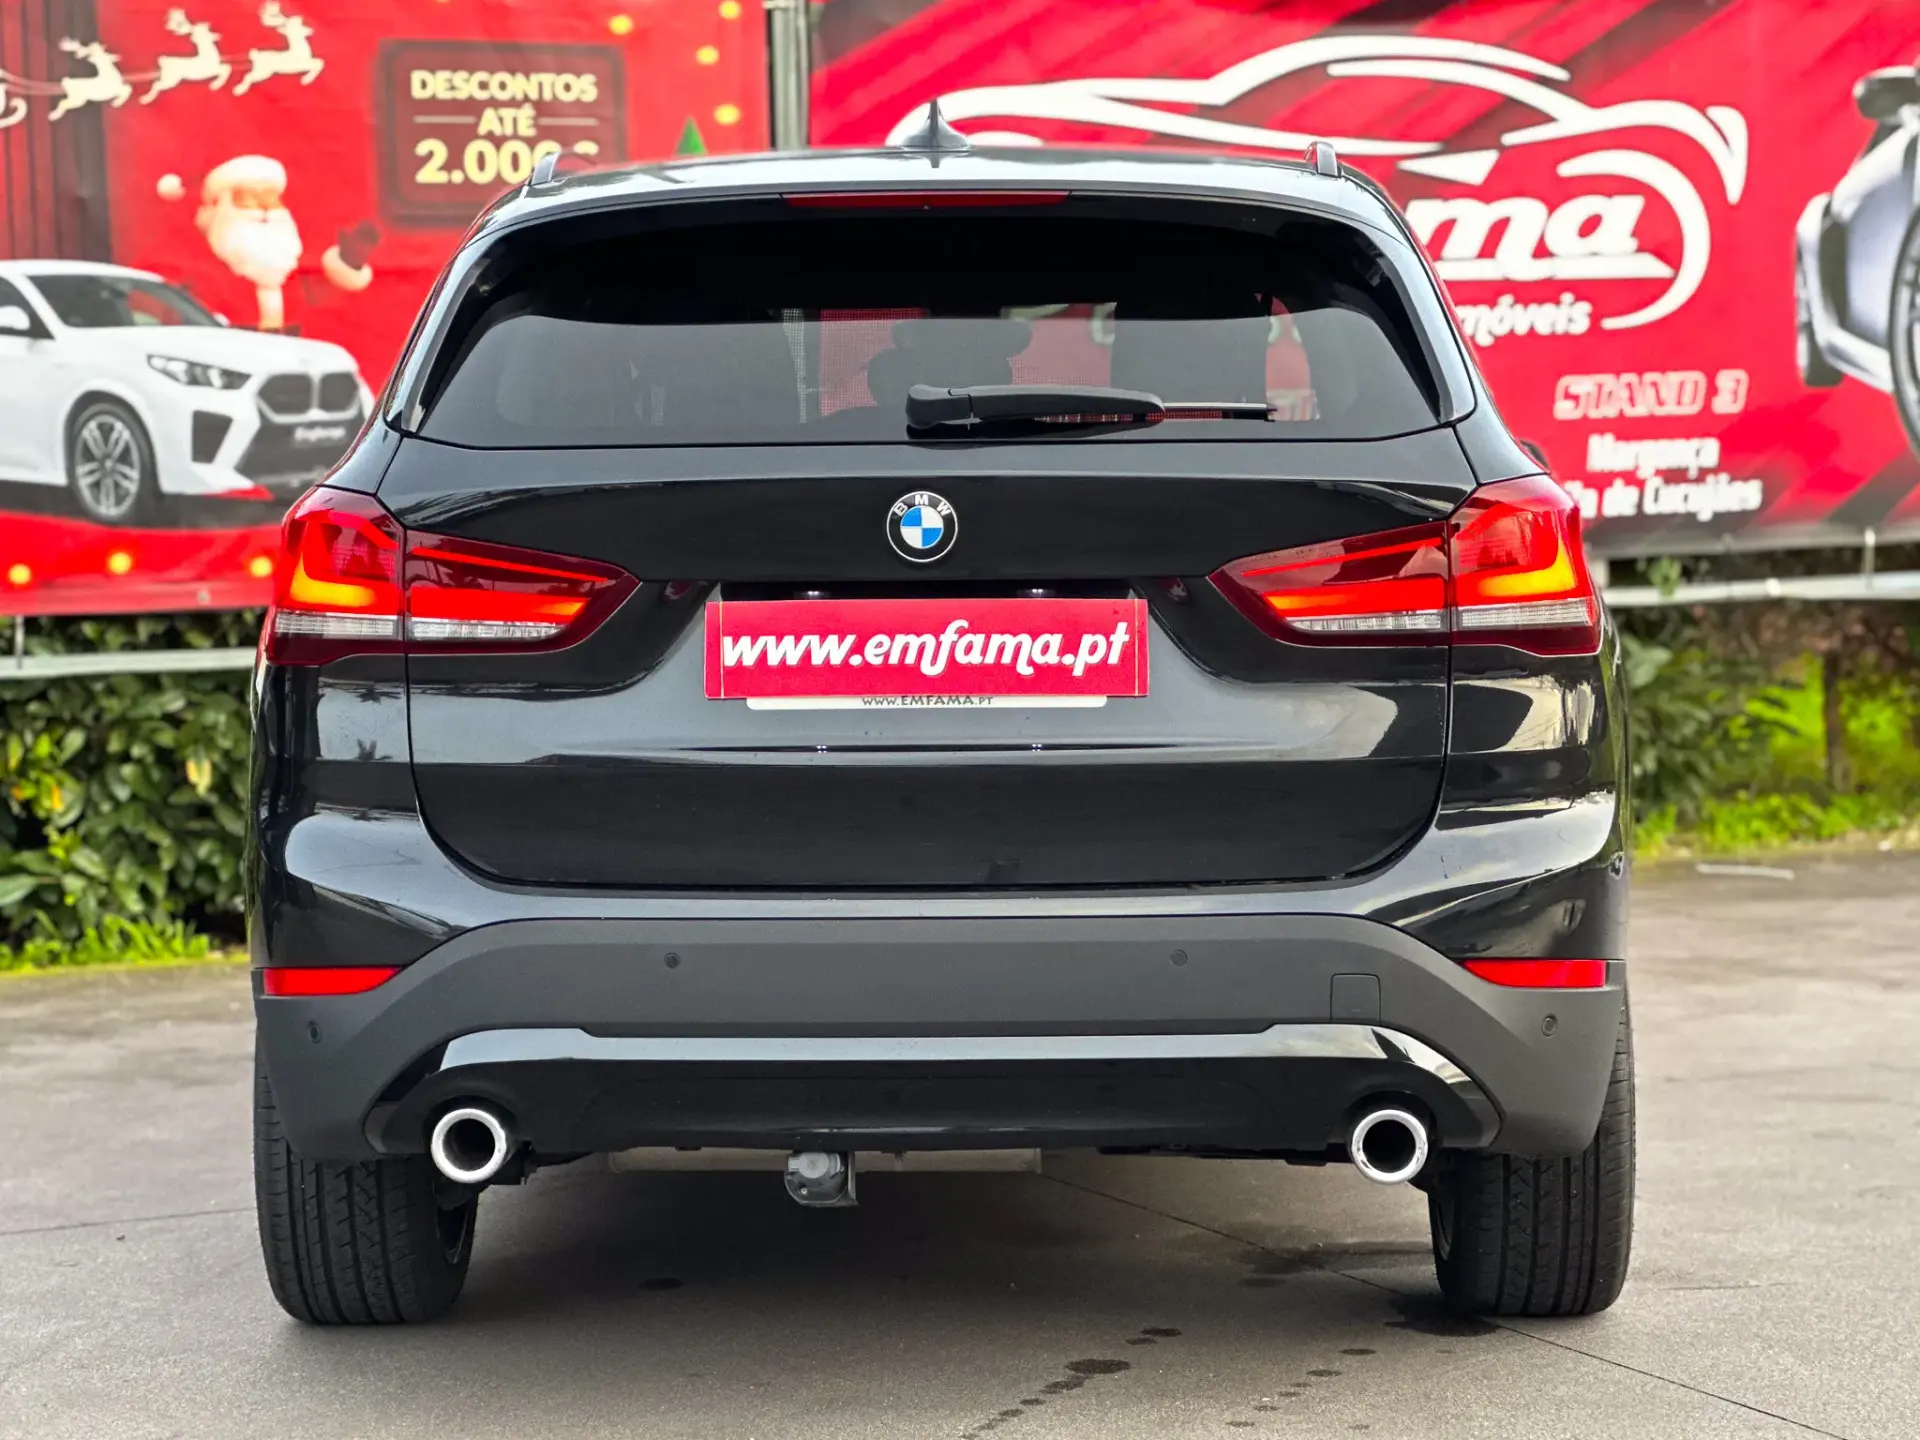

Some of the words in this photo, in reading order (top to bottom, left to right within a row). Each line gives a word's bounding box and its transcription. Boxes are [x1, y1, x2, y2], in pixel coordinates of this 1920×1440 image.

[410, 69, 598, 102] DESCONTOS
[477, 102, 537, 136] ATÉ
[1553, 372, 1708, 420] STAND
[1711, 368, 1750, 414] 3
[893, 494, 952, 517] BMW
[1601, 478, 1641, 517] de
[723, 619, 1130, 676] www.emfama.pt
